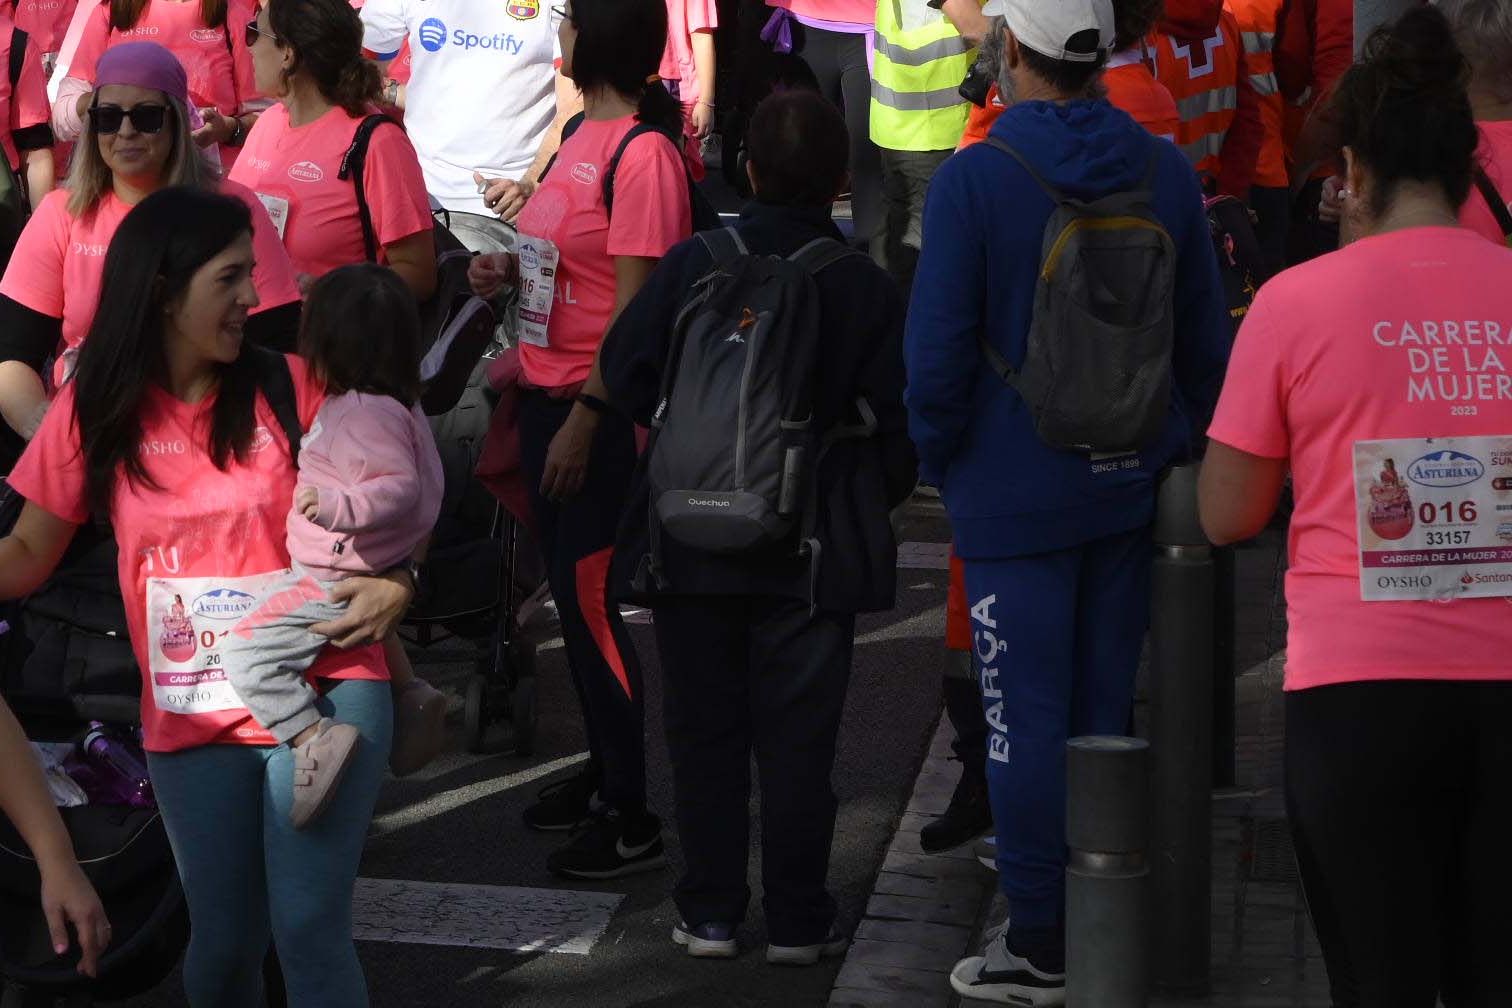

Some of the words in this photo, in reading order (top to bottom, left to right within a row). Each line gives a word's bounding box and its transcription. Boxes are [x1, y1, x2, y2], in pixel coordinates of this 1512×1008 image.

[452, 29, 524, 56] Spotify
[74, 244, 107, 257] OYSH
[1407, 347, 1451, 373] DE
[1463, 347, 1505, 372] LA
[1407, 374, 1512, 402] MUJER
[1450, 405, 1478, 416] 2023
[140, 440, 185, 456] YSHO
[1091, 461, 1118, 473] SINCE
[1414, 465, 1479, 480] ASTURIANA
[688, 498, 730, 507] Quechua
[1419, 500, 1478, 524] 016
[1425, 530, 1471, 546] 33157
[139, 545, 180, 574] TU
[1381, 554, 1429, 564] CARRERA
[1431, 554, 1445, 562] DE
[1447, 552, 1460, 561] LA
[1462, 551, 1497, 561] MUJER
[1377, 575, 1432, 589] OYSHO
[170, 674, 208, 684] CARRERA
[210, 671, 223, 680] DE
[970, 593, 1010, 765] BARÇA
[167, 692, 211, 705] OYSHO
